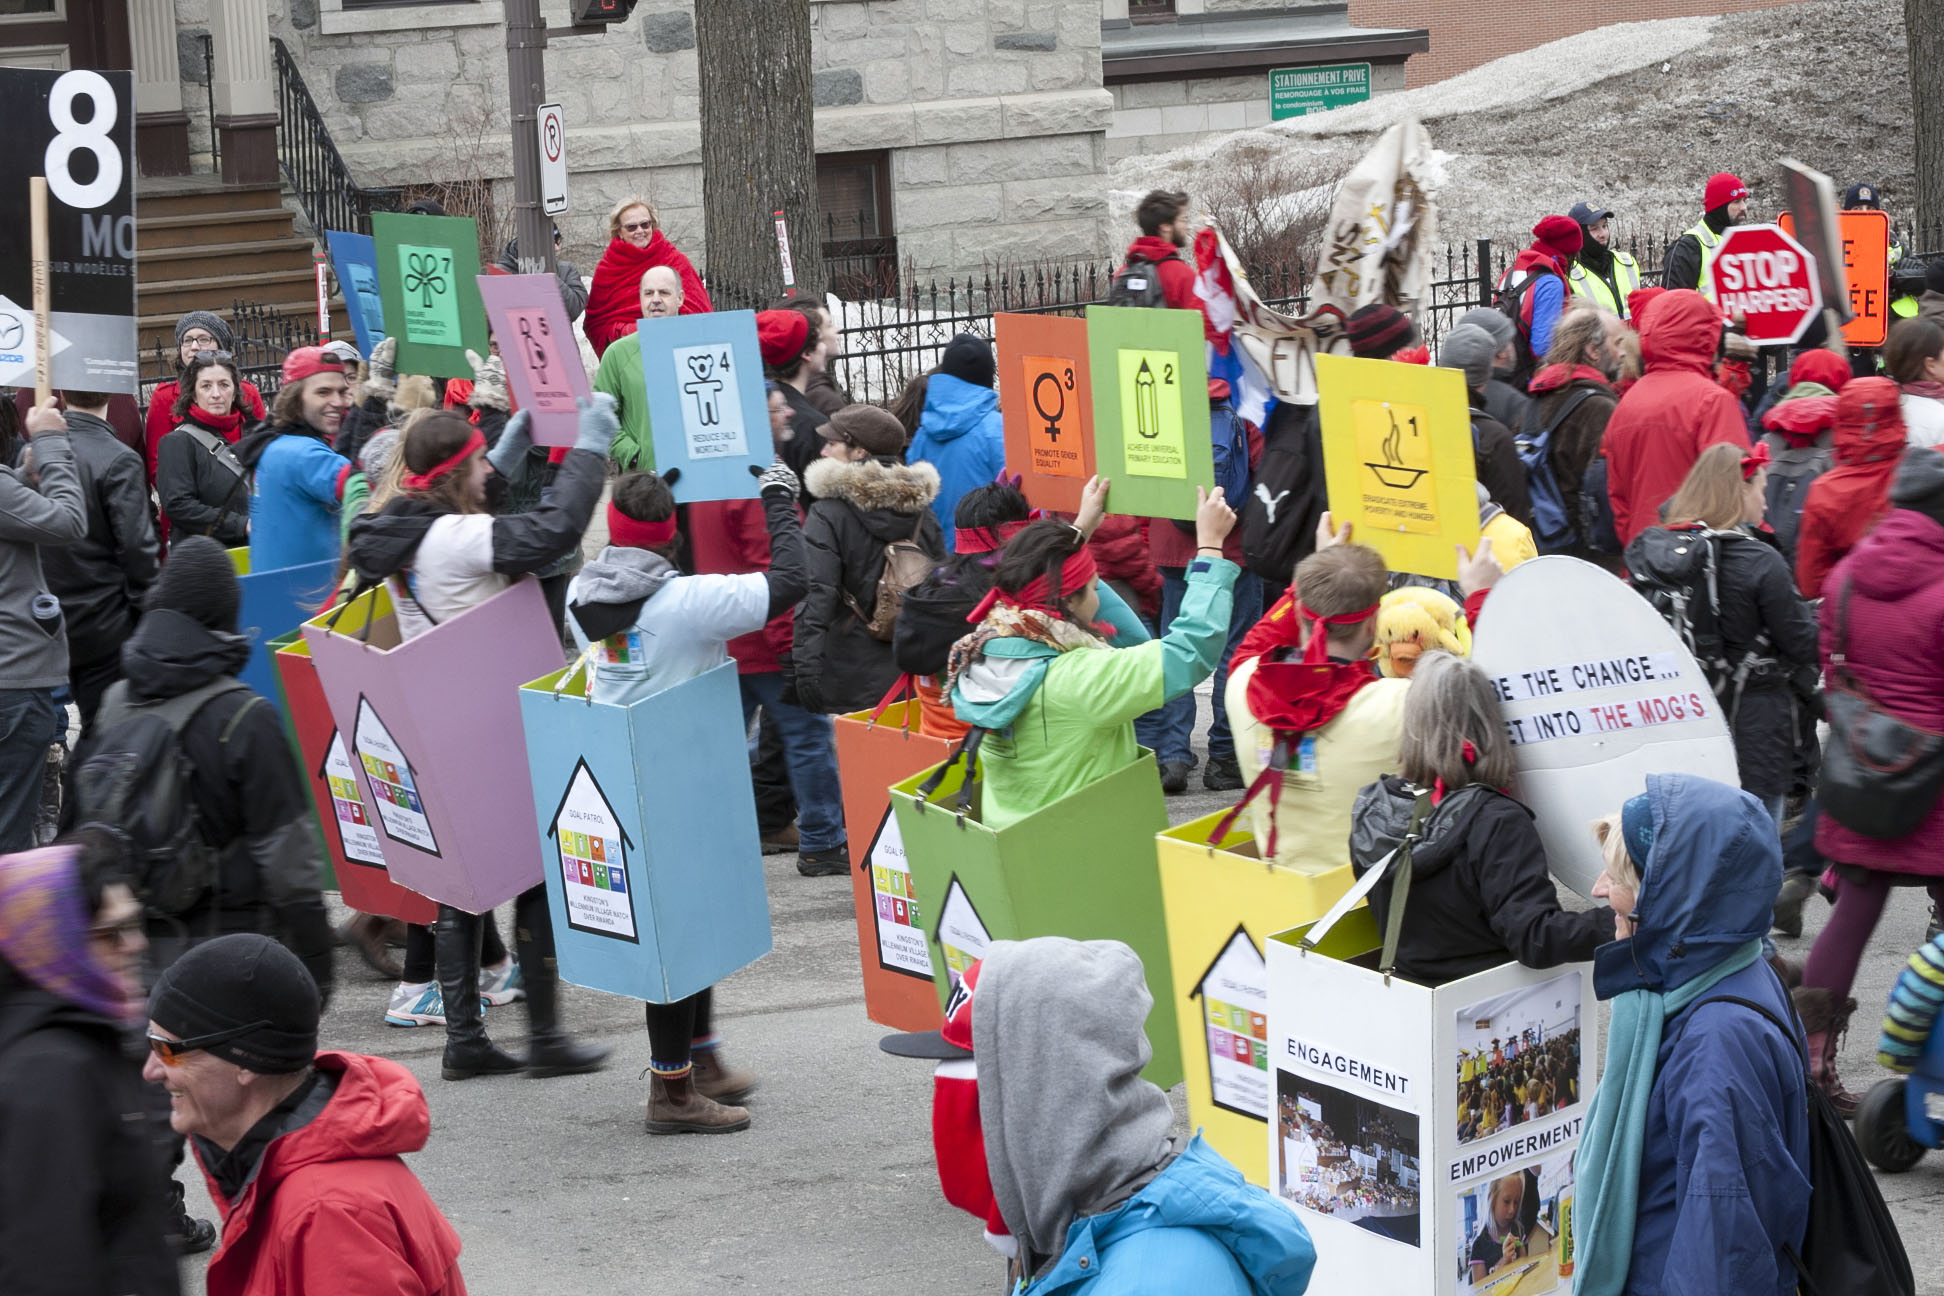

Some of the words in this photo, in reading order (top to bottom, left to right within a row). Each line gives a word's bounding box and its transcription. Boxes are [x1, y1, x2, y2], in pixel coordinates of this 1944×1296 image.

[1275, 71, 1340, 87] STATIONNEMENT
[1275, 89, 1322, 99] REMORQUAGE
[1346, 86, 1366, 94] FRAIS
[1283, 100, 1323, 109] condominium
[44, 70, 123, 208] 8
[48, 261, 70, 272] SUR
[74, 260, 126, 276] MODÈLES
[441, 257, 451, 274] 7
[1720, 250, 1799, 290] STOP
[1720, 287, 1812, 315] HARPER!
[538, 317, 549, 335] 5
[720, 351, 730, 372] 4
[1065, 368, 1075, 391] 3
[1163, 363, 1174, 385] 2
[1408, 416, 1418, 437] 1
[1034, 448, 1060, 459] PROMOTE
[1061, 450, 1079, 460] GENDER
[1128, 454, 1151, 463] PRIMARY
[1152, 456, 1182, 465] EDUCATION
[1036, 459, 1061, 468] EQUALITY
[1490, 677, 1514, 702] BE
[1522, 669, 1562, 696] THE
[1533, 710, 1581, 739] INTO
[1590, 704, 1632, 731] THE
[1637, 693, 1705, 724] MDG'S
[569, 809, 582, 820] GOAL
[583, 812, 605, 825] PATROL
[583, 912, 595, 922] OVER
[595, 914, 615, 926] RWANDA
[896, 953, 909, 963] OVER
[909, 956, 929, 968] RWANDA
[1288, 1038, 1408, 1094] ENGAGEMENT
[1451, 1118, 1582, 1181] EMPOWERMENT
